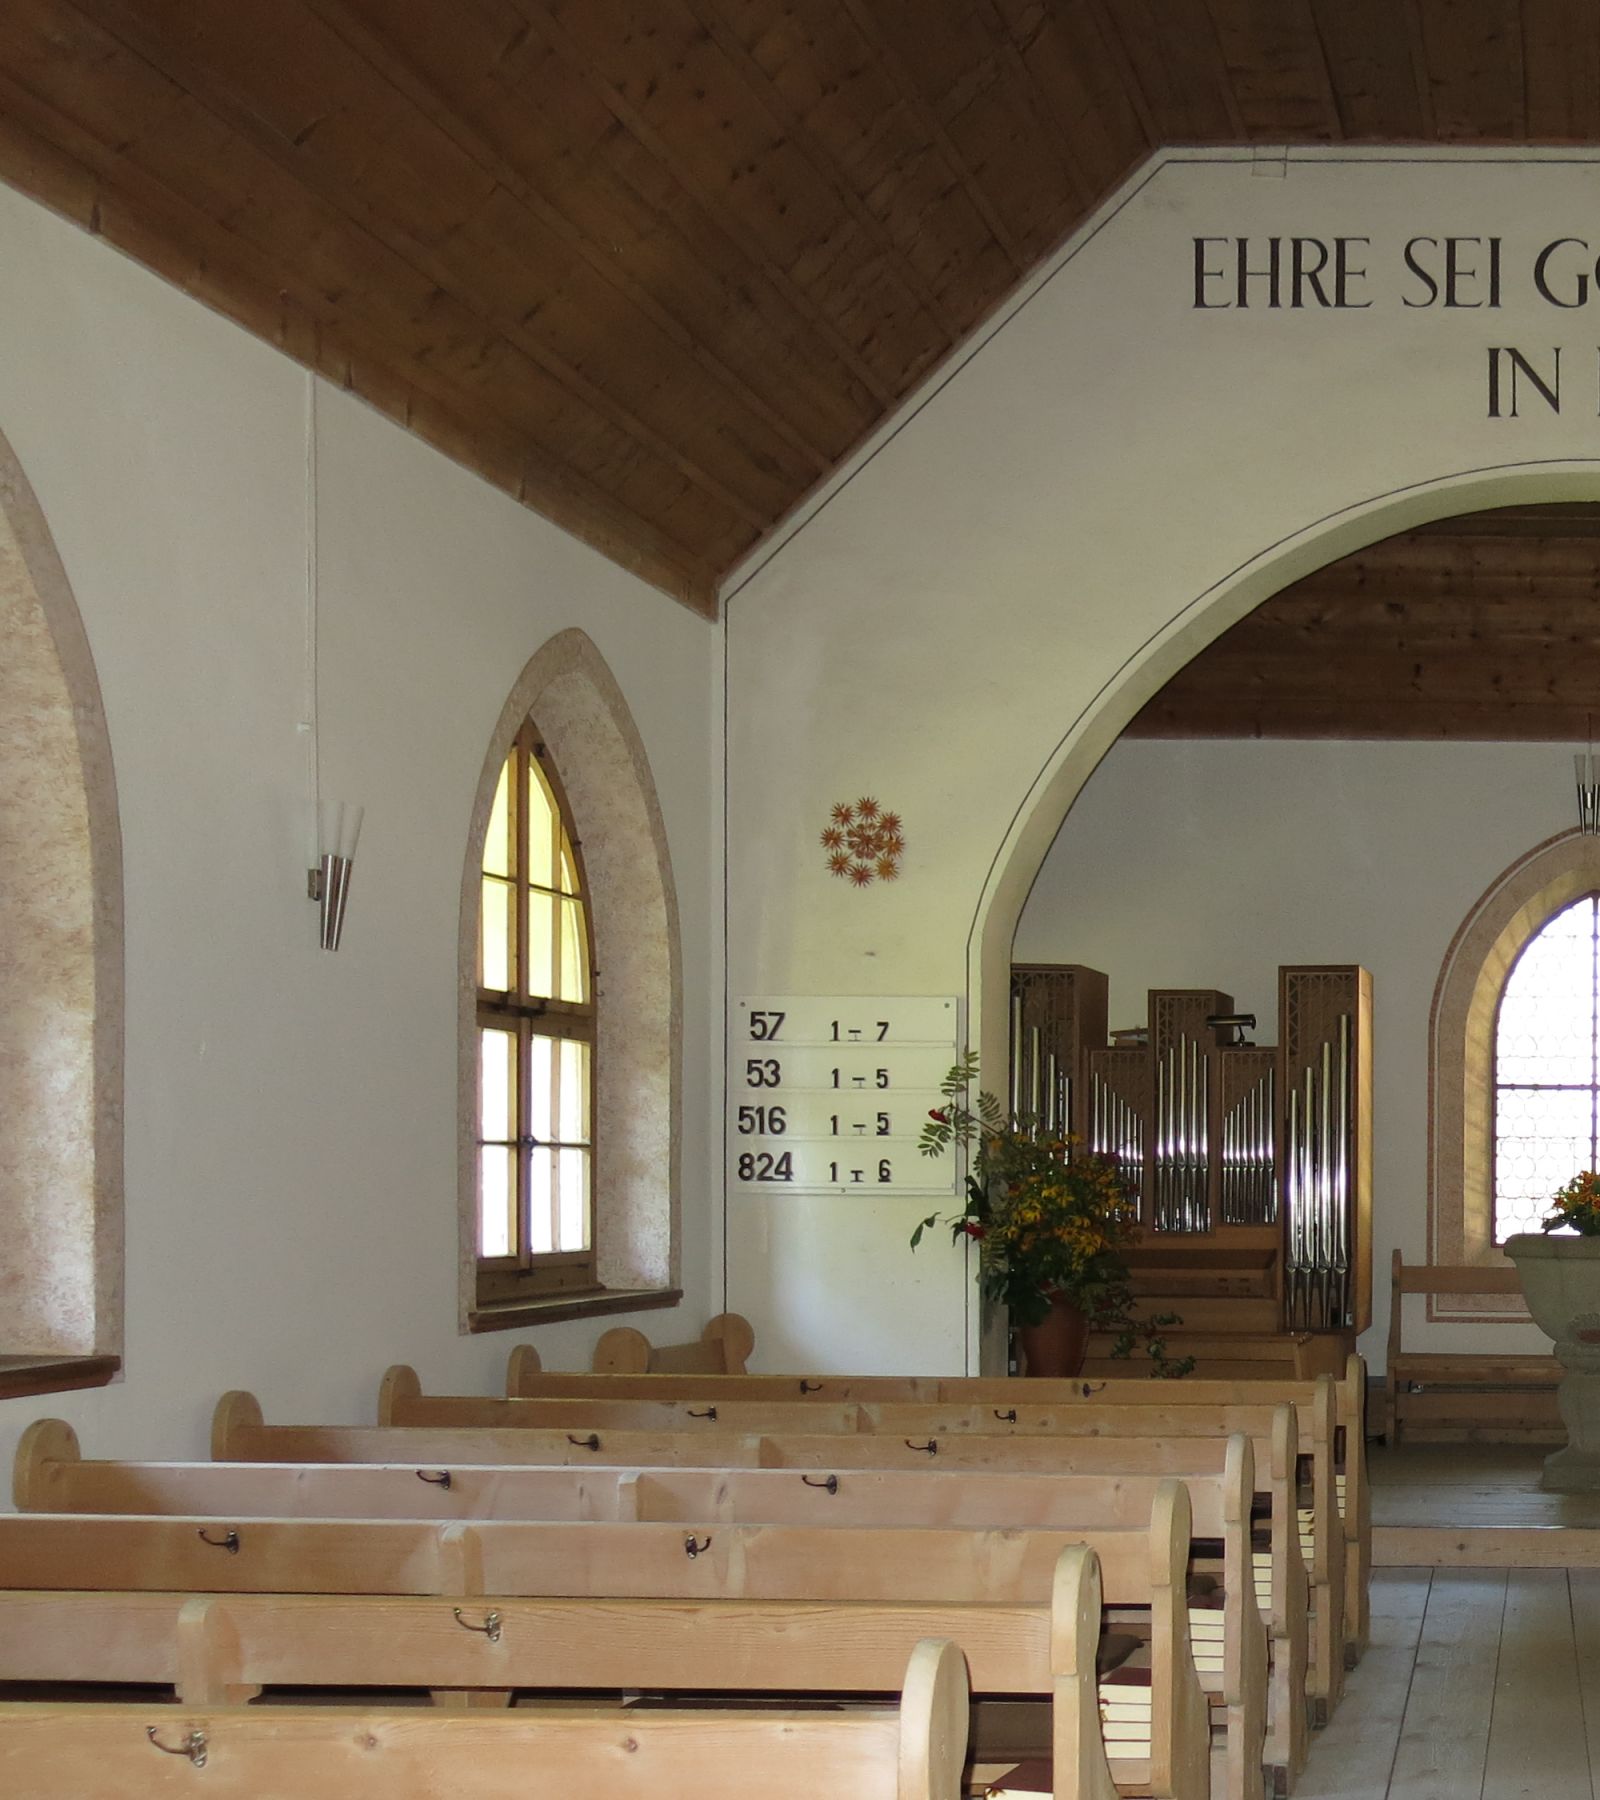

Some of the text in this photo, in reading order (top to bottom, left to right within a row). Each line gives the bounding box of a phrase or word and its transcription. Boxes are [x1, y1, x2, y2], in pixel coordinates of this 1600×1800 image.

[1193, 237, 1373, 308] EHRE
[1402, 237, 1501, 308] SEI
[1487, 347, 1561, 417] IN
[750, 1011, 785, 1041] 57
[747, 1059, 781, 1088] 53
[738, 1106, 786, 1135] 516
[738, 1152, 793, 1182] 824
